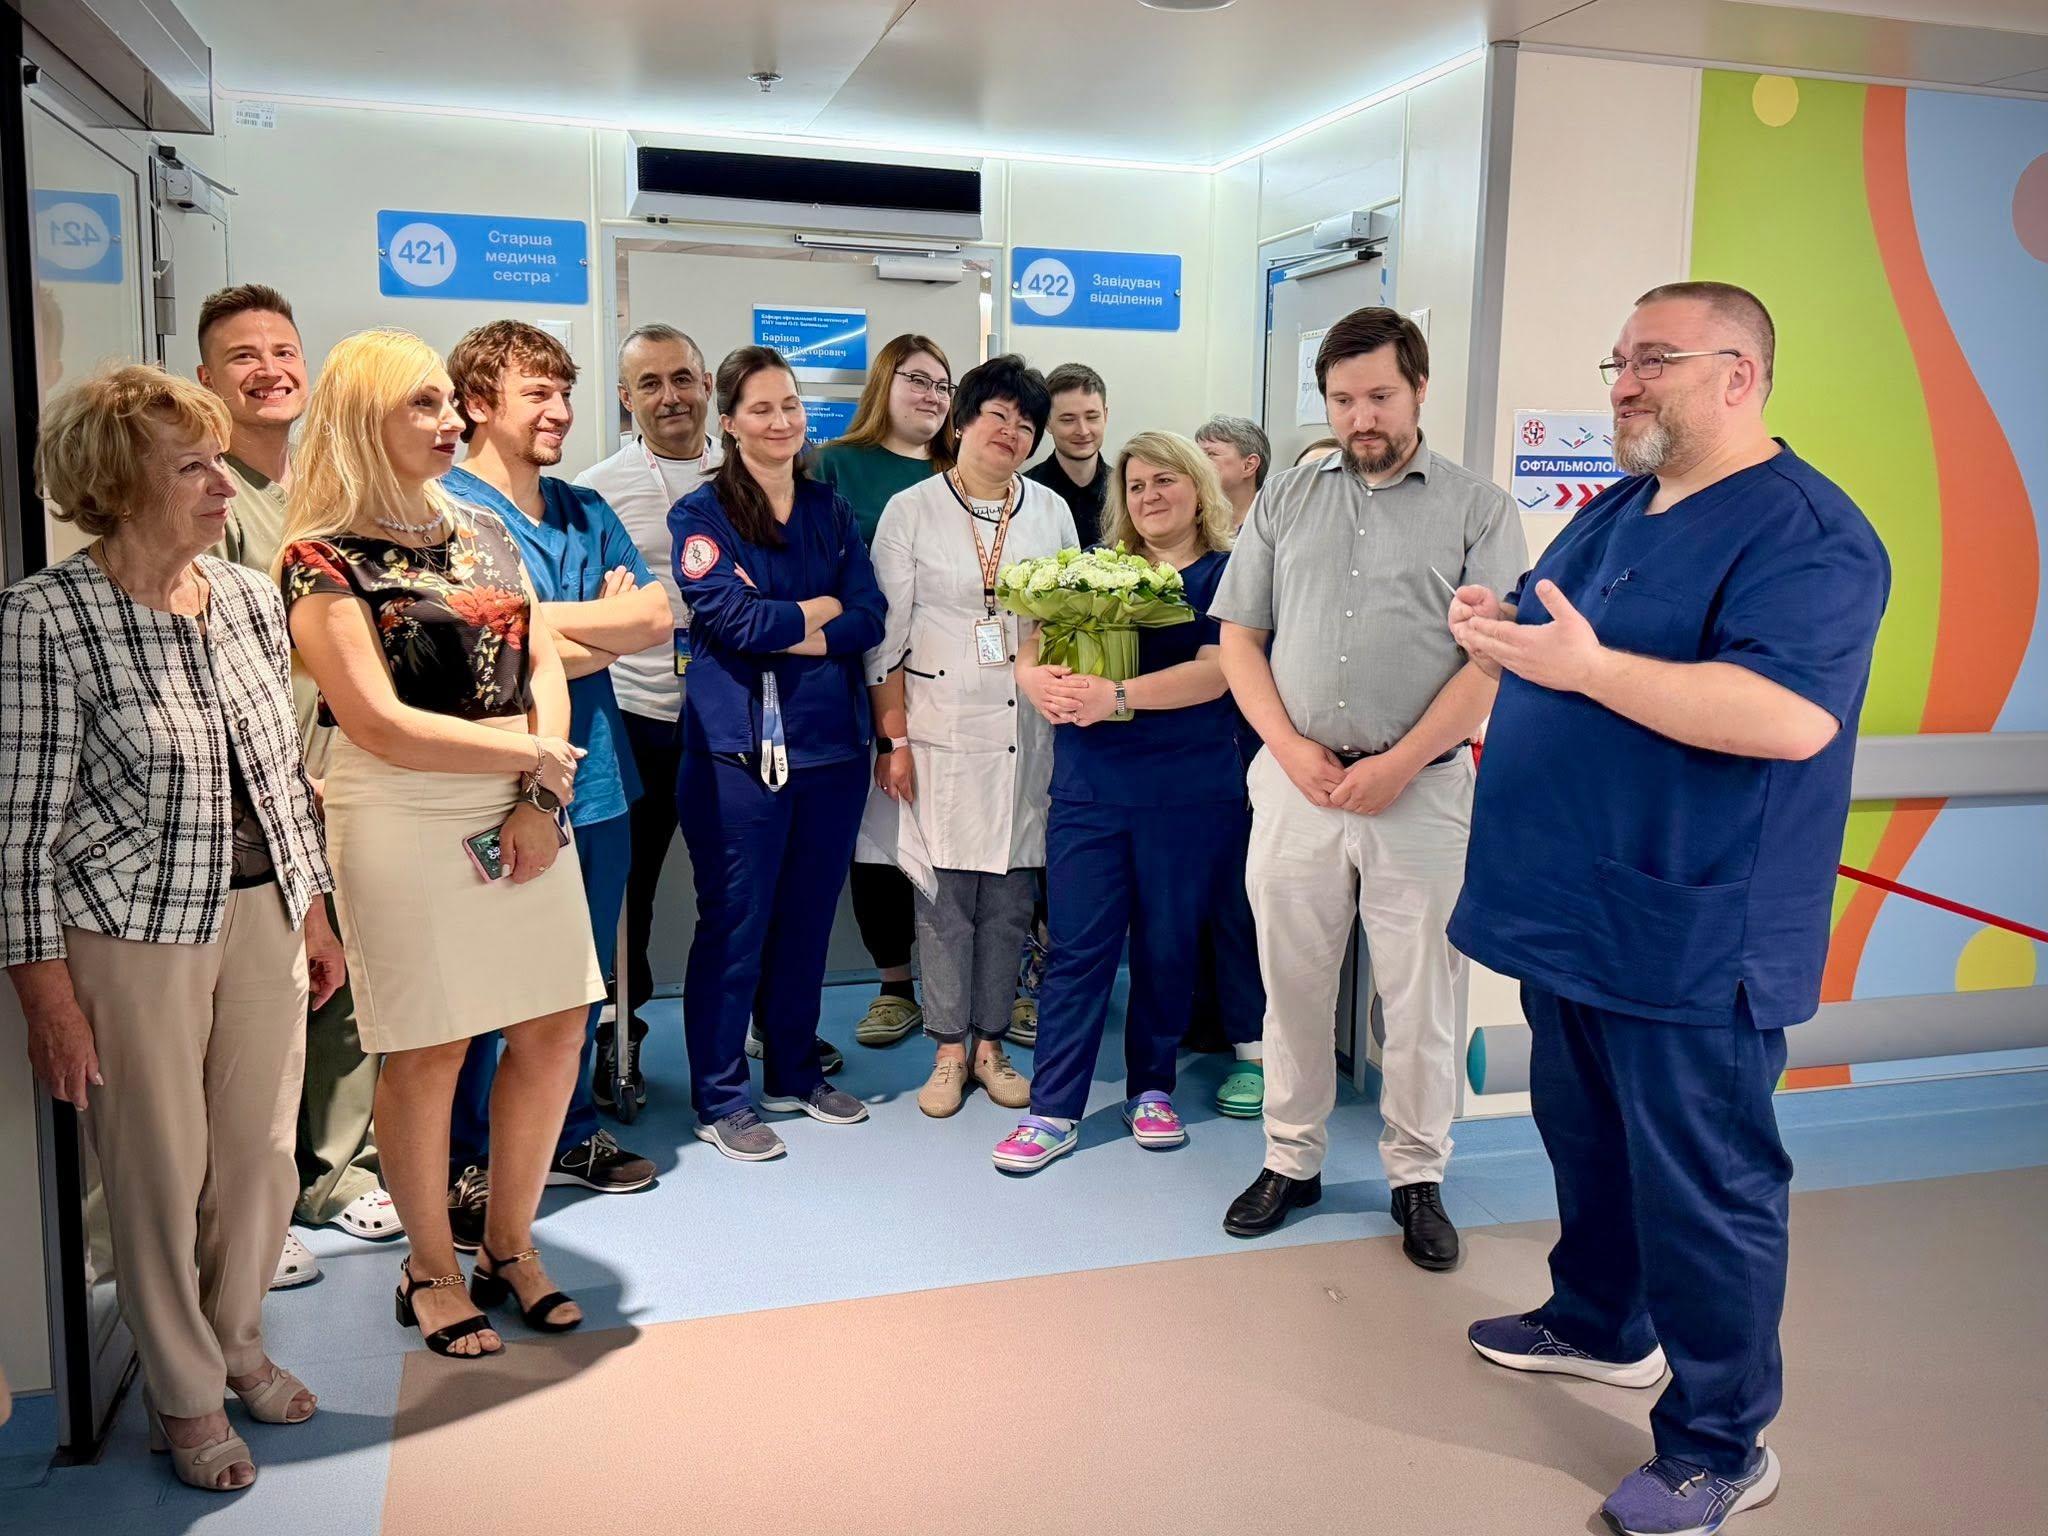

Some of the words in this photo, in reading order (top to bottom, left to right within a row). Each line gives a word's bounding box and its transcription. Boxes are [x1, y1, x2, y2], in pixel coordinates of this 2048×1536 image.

[488, 230, 553, 247] Старша
[399, 240, 445, 265] 421
[485, 250, 557, 265] медична
[493, 271, 551, 285] сестра
[1028, 273, 1069, 297] 422
[1092, 273, 1161, 289] Завідувач
[1090, 291, 1162, 306] відділення
[762, 332, 800, 344] Барінов
[792, 345, 847, 358] Вікторович
